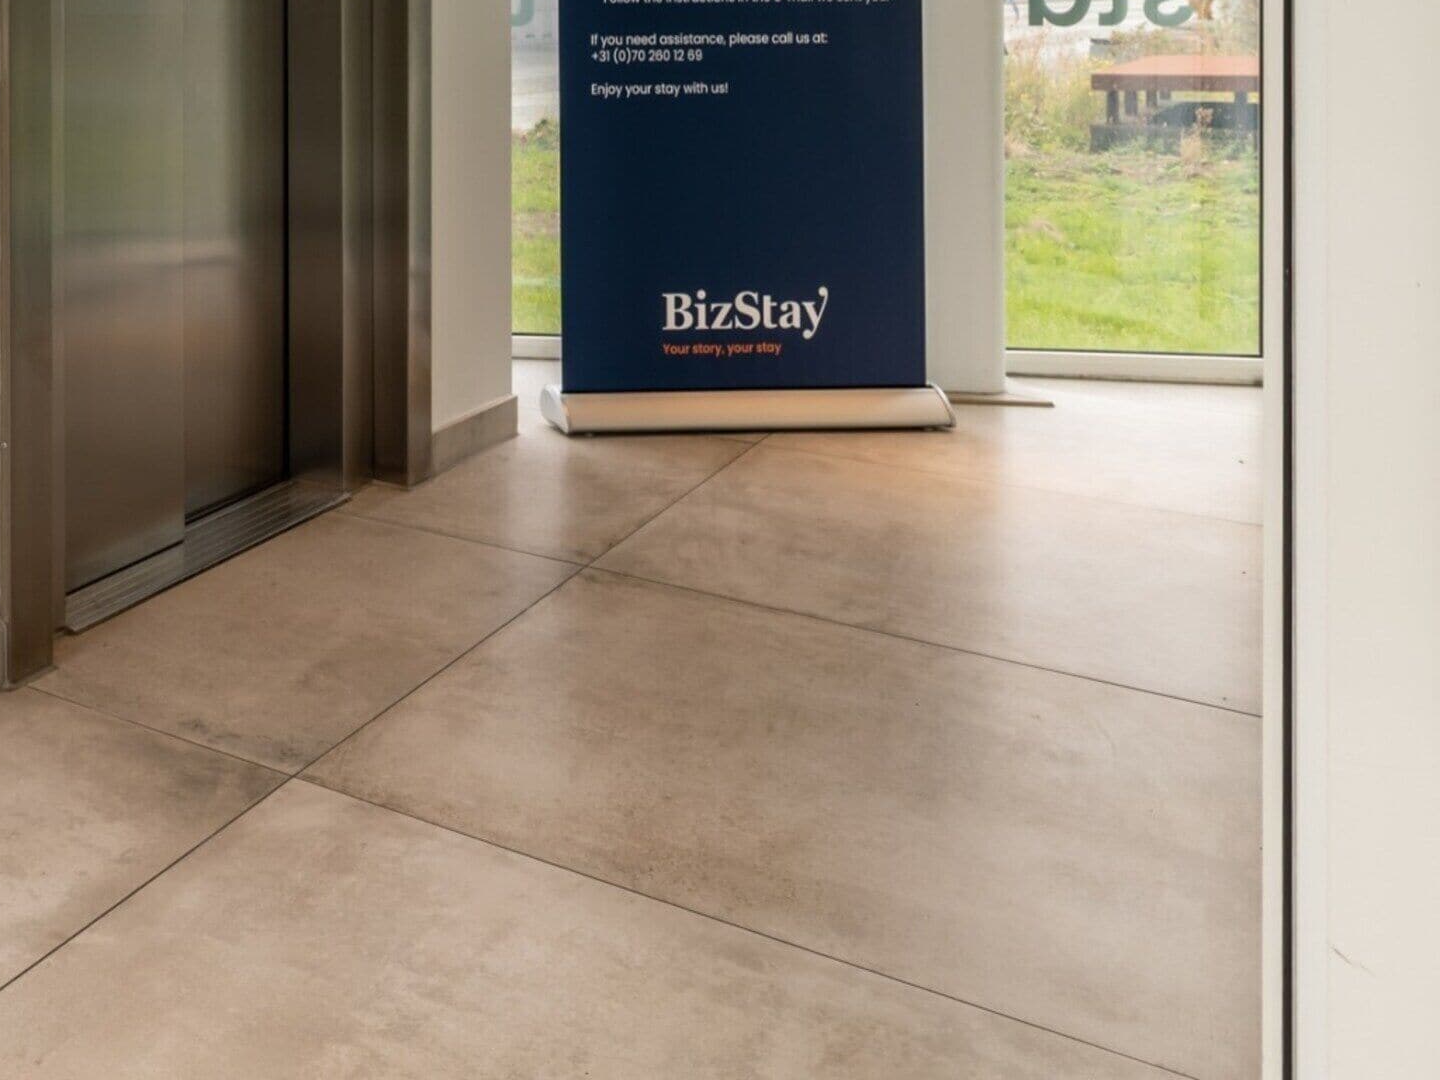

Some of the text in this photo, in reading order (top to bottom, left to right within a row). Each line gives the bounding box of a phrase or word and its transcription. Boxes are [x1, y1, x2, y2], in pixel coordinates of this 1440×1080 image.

[590, 33, 599, 46] If
[599, 35, 624, 49] you
[625, 33, 657, 49] need
[658, 32, 727, 47] assistance,
[728, 32, 770, 48] please
[771, 31, 794, 45] call
[795, 33, 811, 45] us
[590, 49, 611, 63] +31
[612, 47, 647, 65] (0)70
[673, 48, 685, 62] 12
[590, 81, 729, 99] Enjoy your stay with us!
[661, 285, 830, 340] BizStay
[662, 343, 691, 356] Your
[726, 343, 755, 357] your
[755, 341, 782, 356] stay
